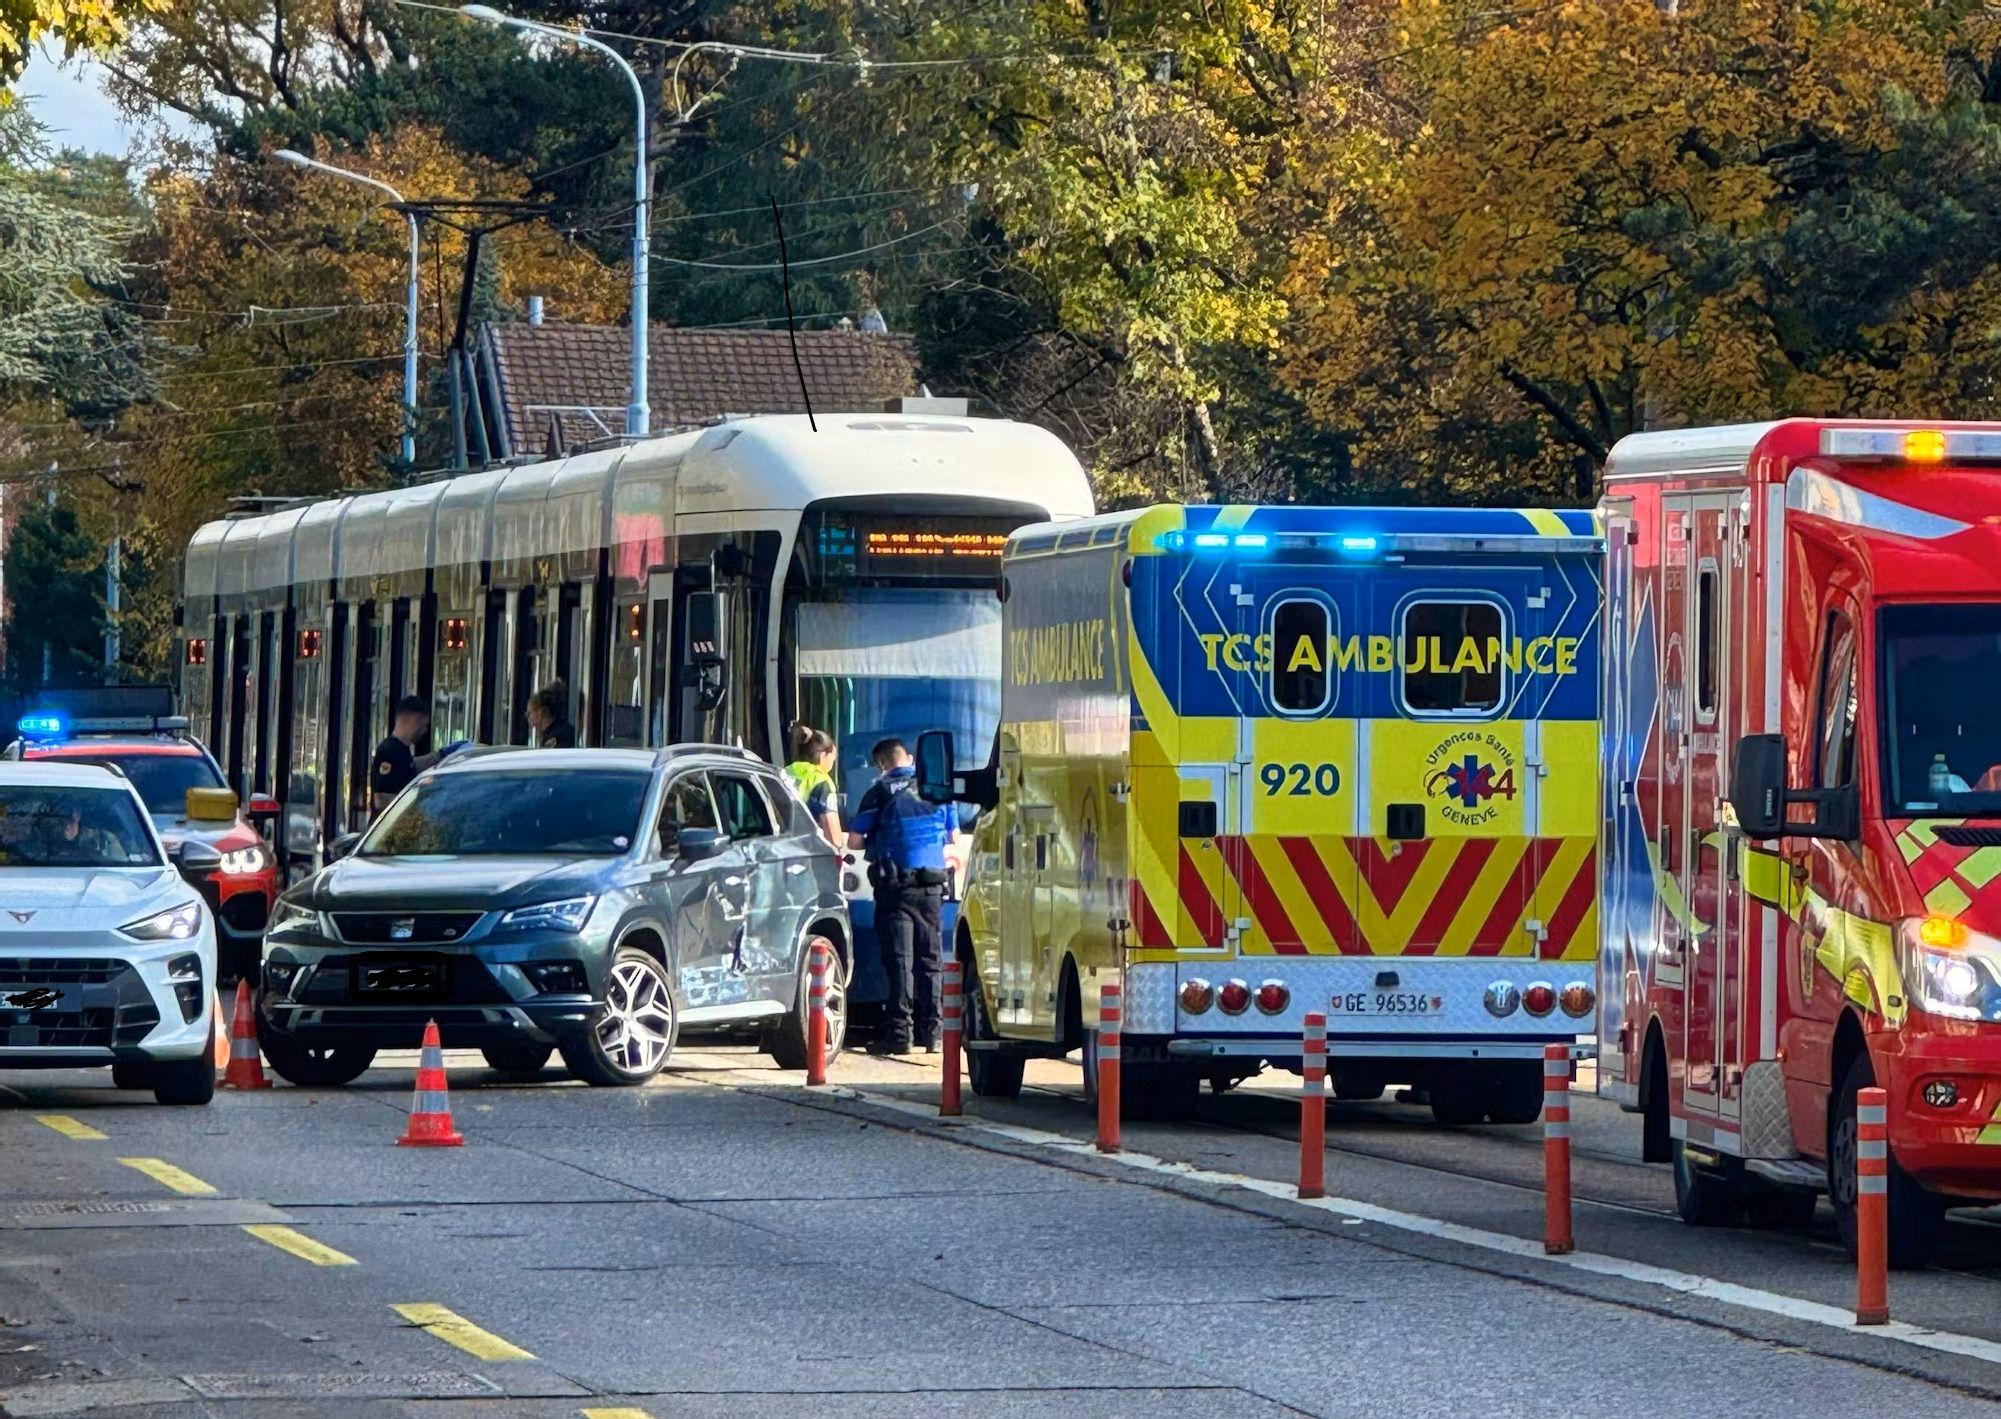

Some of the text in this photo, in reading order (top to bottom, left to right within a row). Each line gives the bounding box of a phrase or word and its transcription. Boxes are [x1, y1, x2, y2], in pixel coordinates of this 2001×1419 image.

[1200, 633, 1578, 674] TCS AMBULANCE
[1426, 731, 1482, 766] Urgences
[1261, 763, 1340, 796] 920
[1345, 993, 1428, 1012] GE 96536
